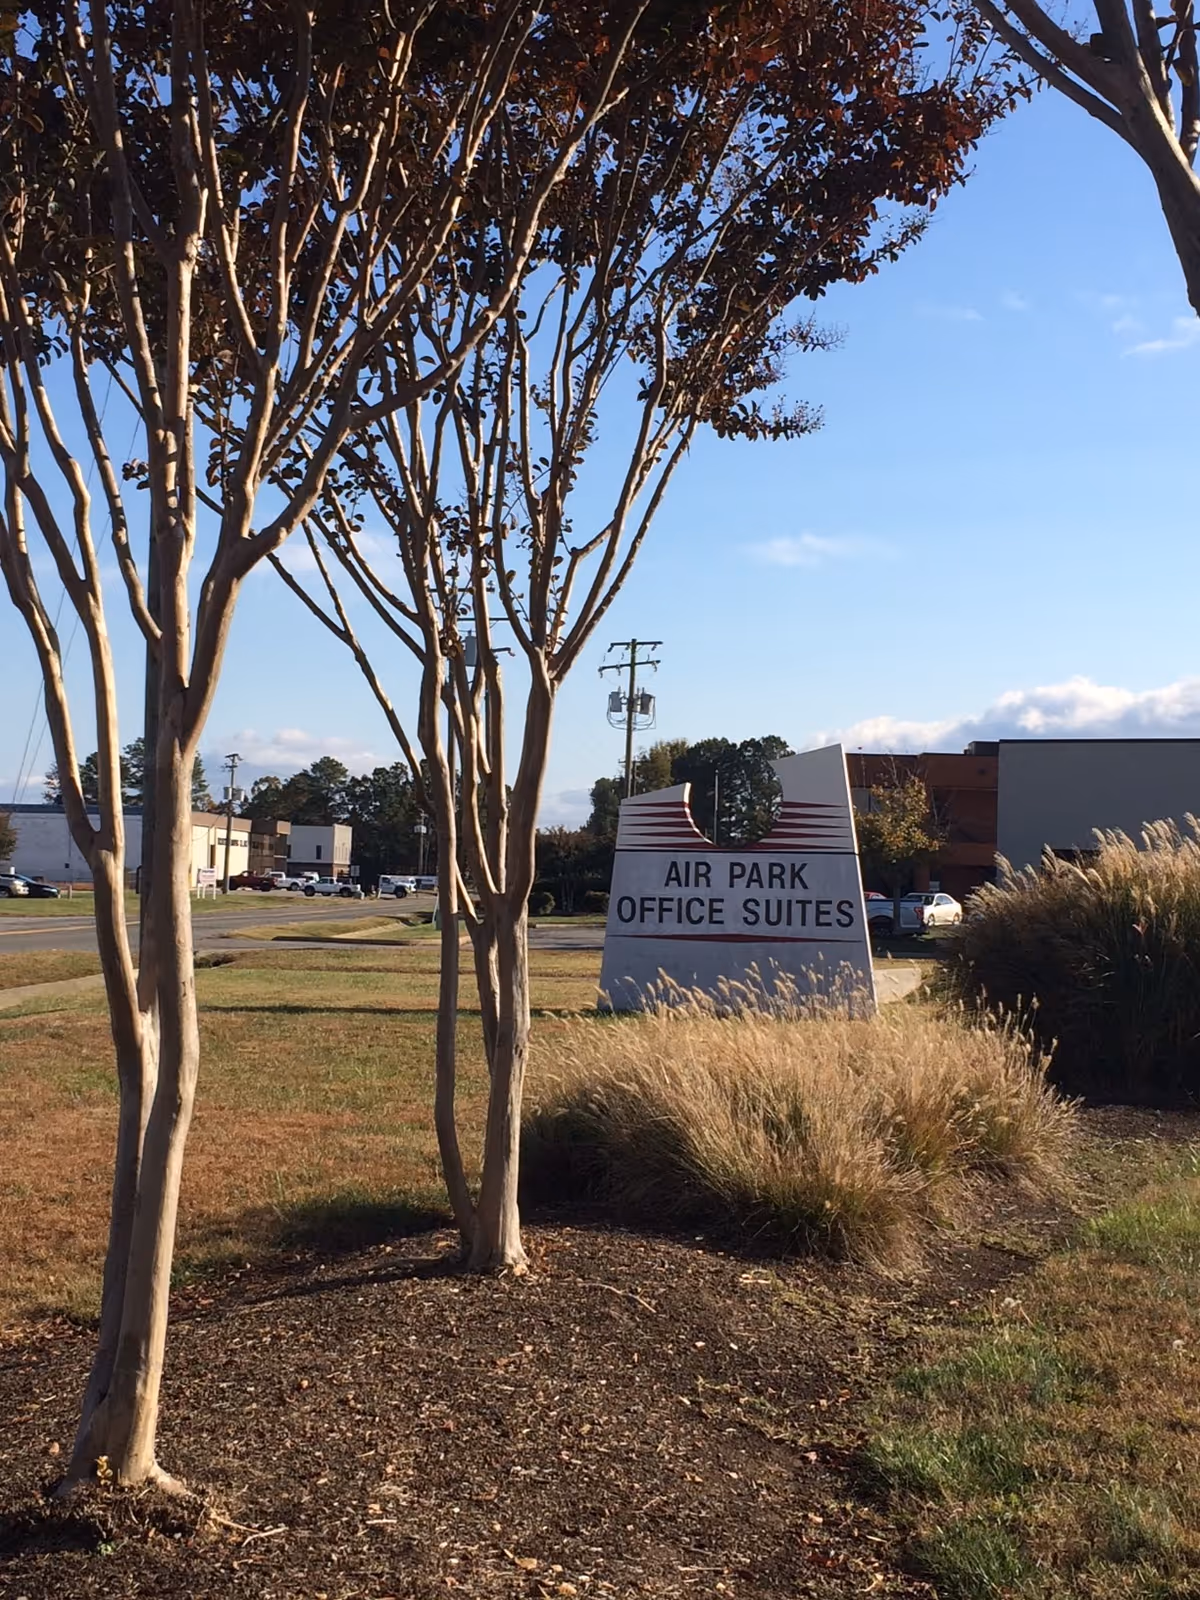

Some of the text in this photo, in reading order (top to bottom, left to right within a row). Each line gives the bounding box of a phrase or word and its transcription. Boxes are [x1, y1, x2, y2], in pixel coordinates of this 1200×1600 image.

[664, 861, 808, 889] AIR PARK
[617, 896, 854, 927] OFFICE SUITES
